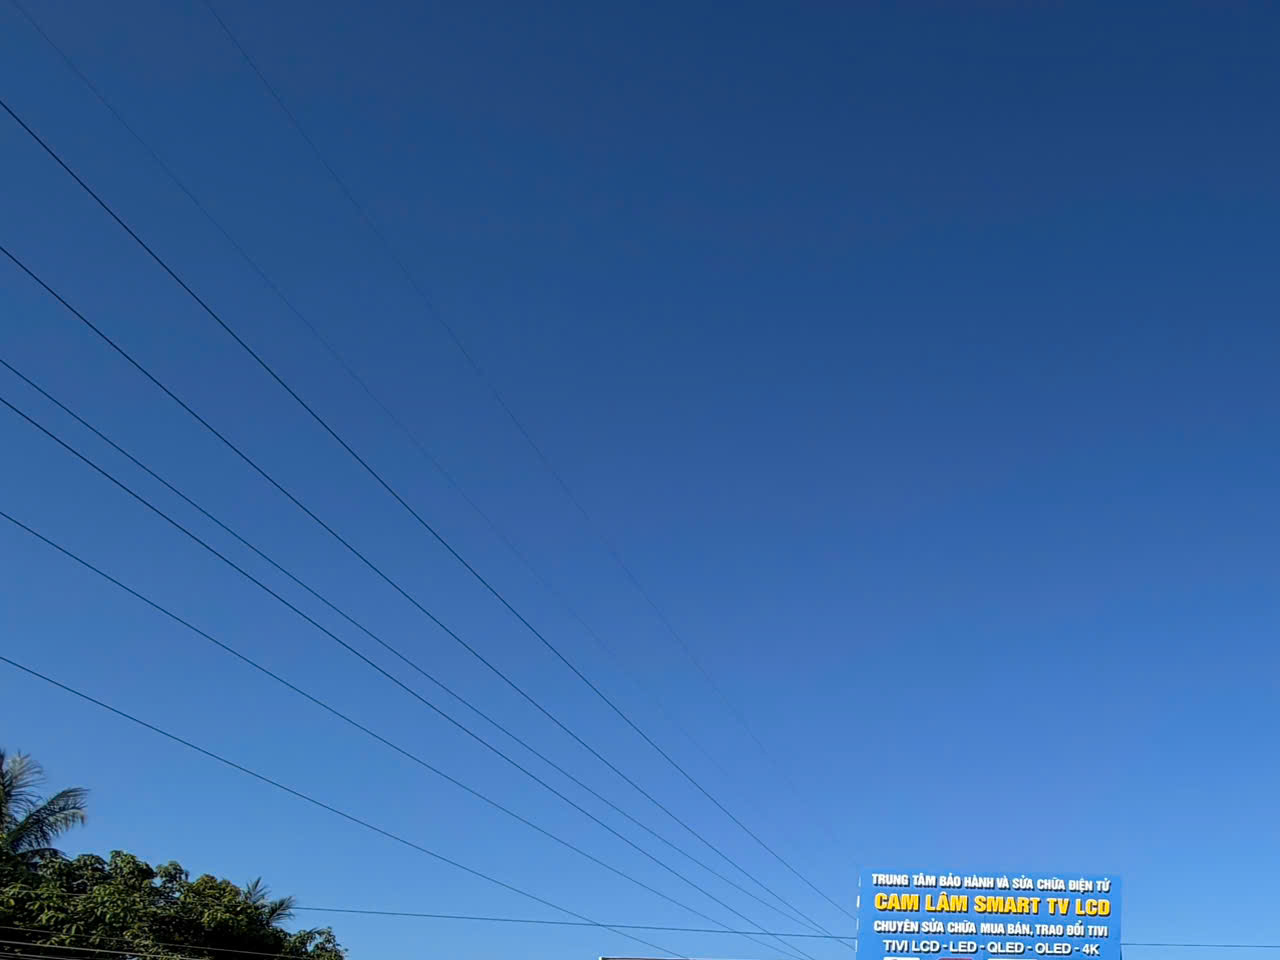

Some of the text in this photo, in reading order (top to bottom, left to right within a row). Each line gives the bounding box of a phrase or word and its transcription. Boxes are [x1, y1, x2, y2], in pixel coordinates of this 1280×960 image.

[872, 873, 909, 887] TRUNG
[912, 875, 936, 888] TÂM
[939, 875, 961, 888] BẢO
[964, 875, 994, 889] HÀNH
[997, 876, 1009, 889] VÀ
[1013, 875, 1034, 890] SỬA
[1037, 877, 1066, 891] CHỮA
[1069, 878, 1093, 894] ĐIỆN
[874, 891, 1111, 917] CAM LÂM SMART TV LCD
[873, 919, 919, 933] CHUYÊN
[922, 918, 945, 934] SỬA
[947, 919, 977, 935] CHỮA
[980, 922, 1005, 935] MUA
[1035, 924, 1064, 937] TRAO
[1087, 924, 1109, 938] TIVI
[883, 939, 1100, 956] TIVI LCD LED QLED OLED 4K
